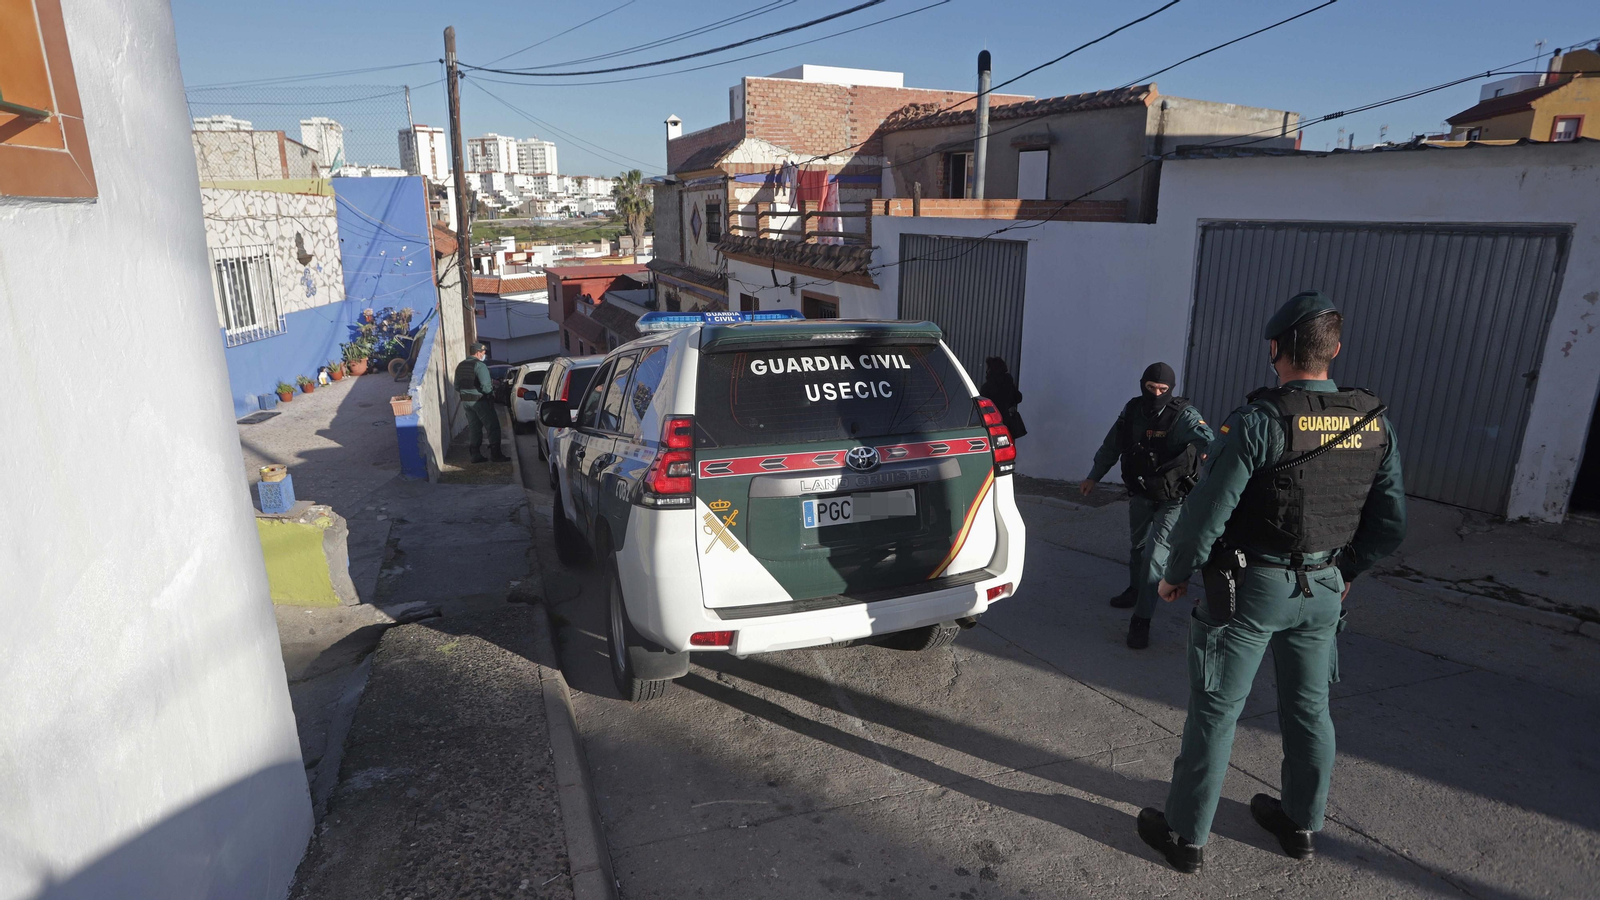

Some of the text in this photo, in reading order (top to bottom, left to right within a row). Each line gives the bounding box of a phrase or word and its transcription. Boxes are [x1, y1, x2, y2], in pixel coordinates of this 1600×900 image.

[750, 354, 911, 376] GUARDIA CIVIL
[804, 380, 893, 402] USECIC
[1298, 416, 1350, 432] GUARDIA
[800, 468, 930, 492] LAND CRUISER
[816, 500, 851, 523] PGC
